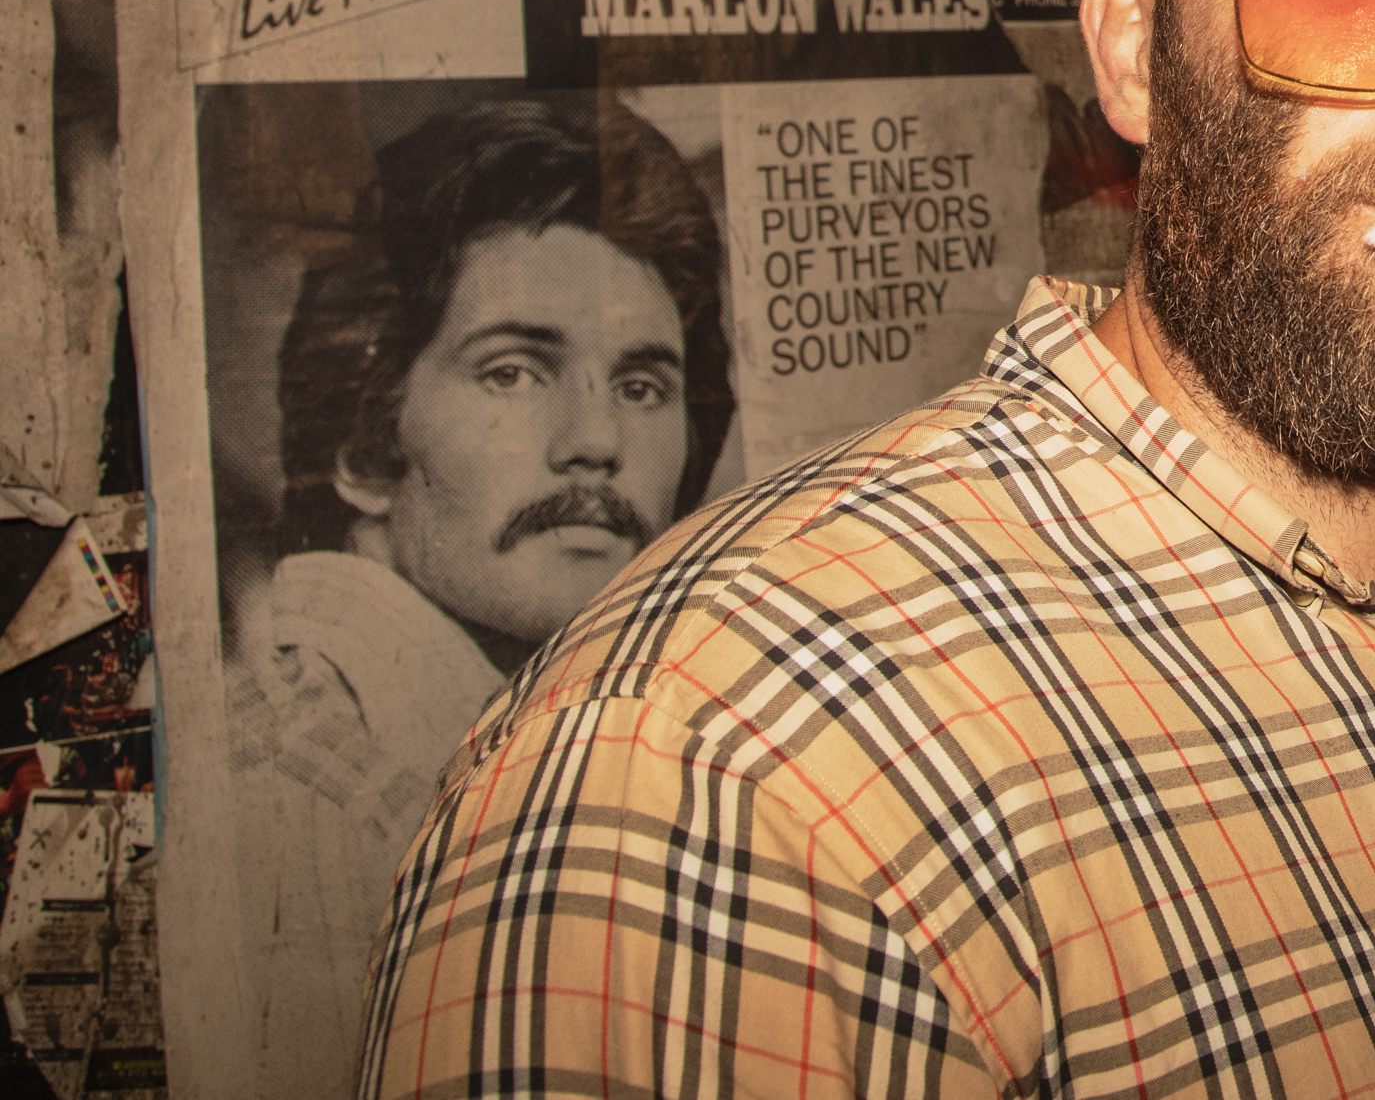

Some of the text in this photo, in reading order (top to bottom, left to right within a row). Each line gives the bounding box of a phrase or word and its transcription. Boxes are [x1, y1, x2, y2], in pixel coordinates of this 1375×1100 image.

[872, 116, 919, 153] OF
[757, 154, 974, 201] THE FINEST
[761, 194, 991, 245] PURVEYORS
[764, 234, 996, 288] OF THE NEW
[768, 279, 948, 332] COUNTRY
